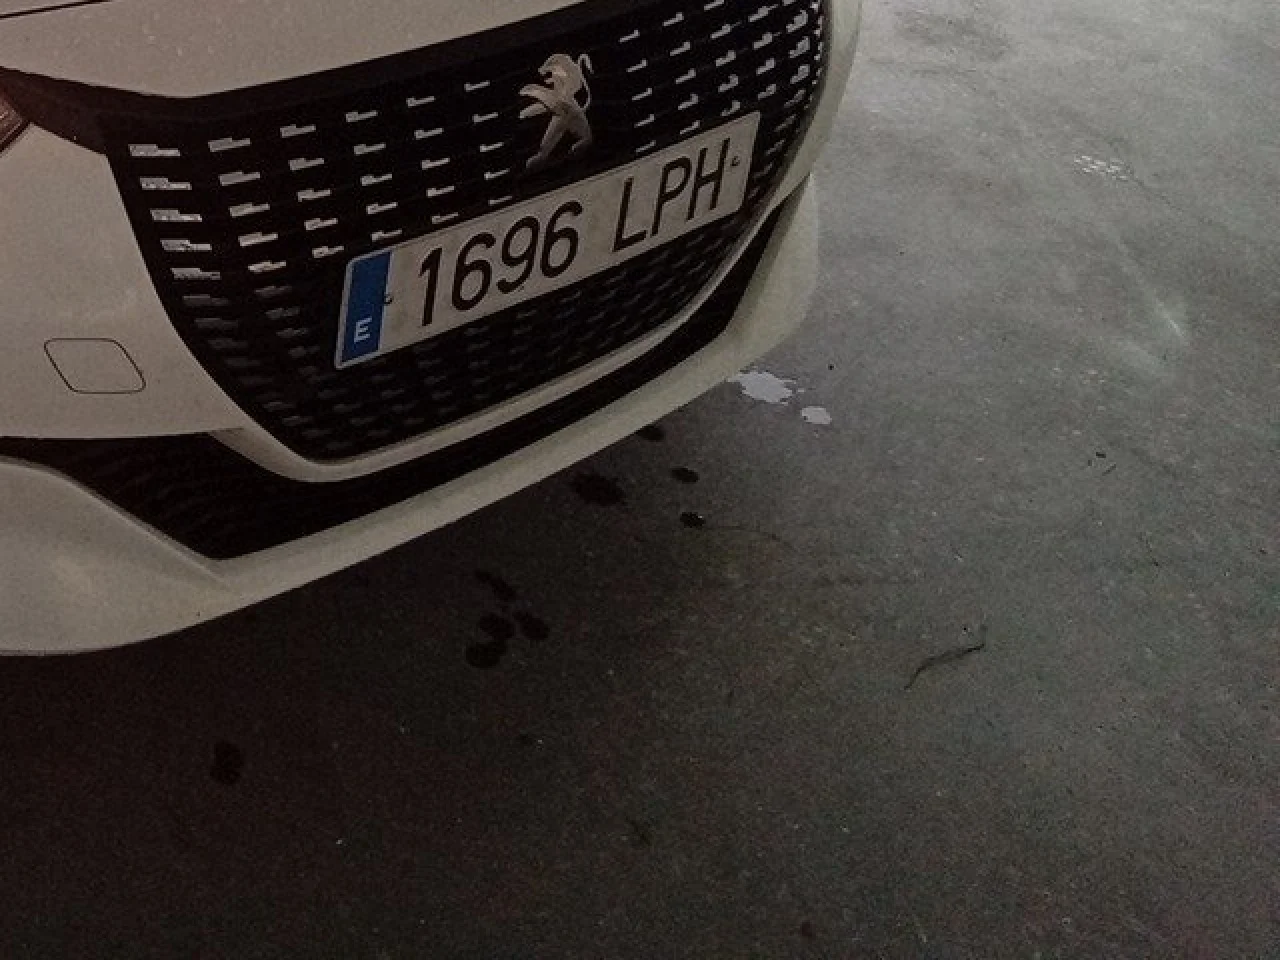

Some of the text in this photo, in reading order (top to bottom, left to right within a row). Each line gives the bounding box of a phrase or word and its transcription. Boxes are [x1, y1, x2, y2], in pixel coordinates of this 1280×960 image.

[354, 136, 731, 343] E 1696 LPH
